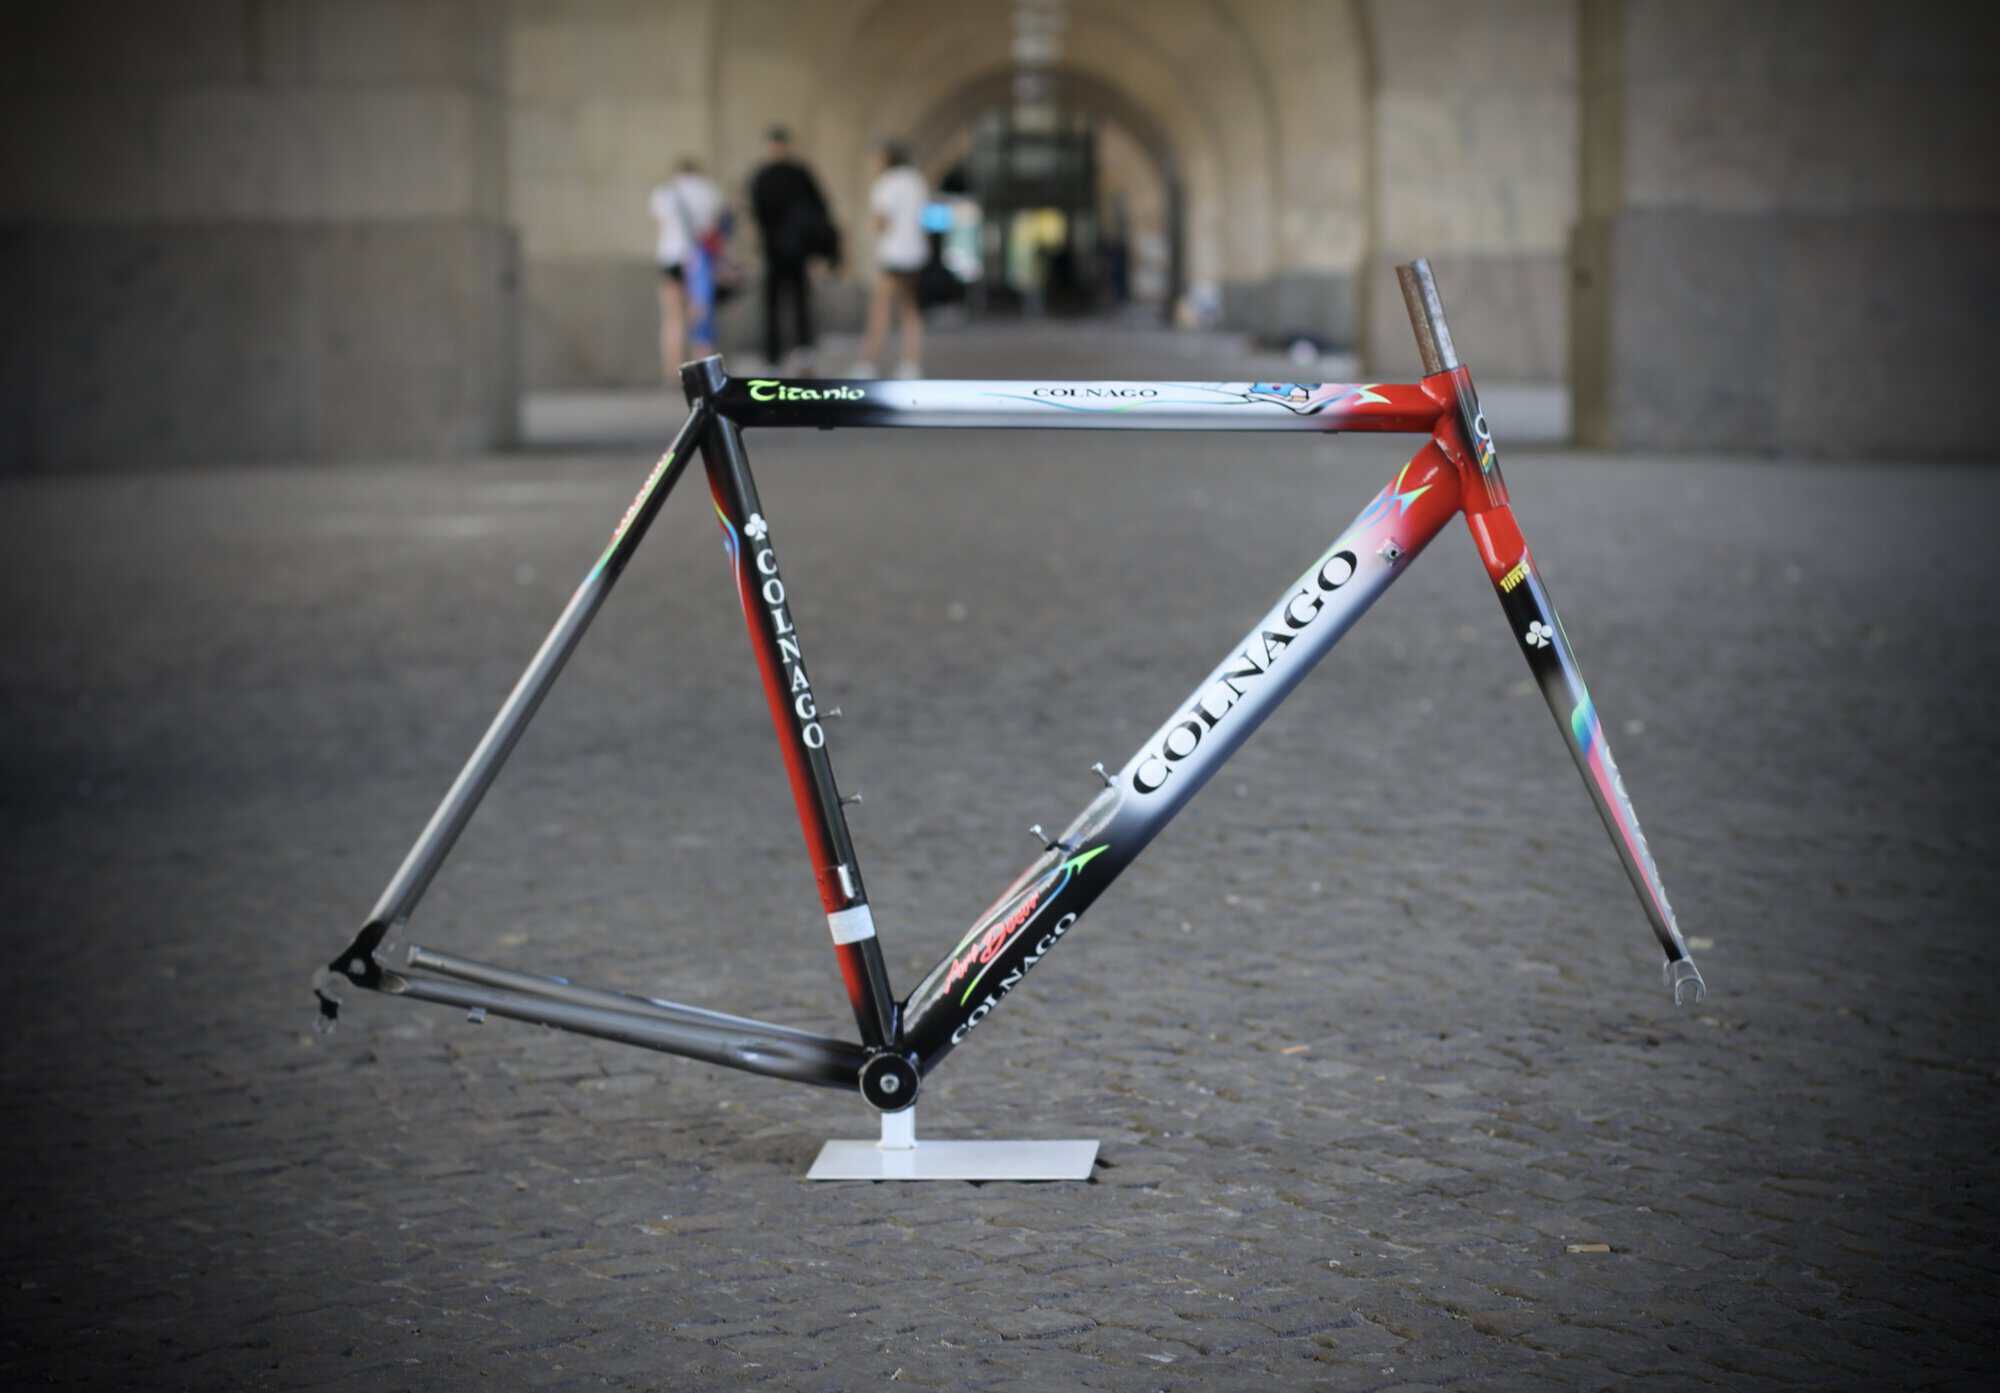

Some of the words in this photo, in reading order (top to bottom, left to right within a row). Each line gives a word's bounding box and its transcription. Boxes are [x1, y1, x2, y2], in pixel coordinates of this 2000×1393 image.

[747, 379, 865, 401] Titanio
[1032, 387, 1158, 398] COLNAGO
[756, 549, 824, 748] COLNAGO
[1133, 550, 1358, 794] COLNAGO
[951, 912, 1077, 1045] COLNAGO
